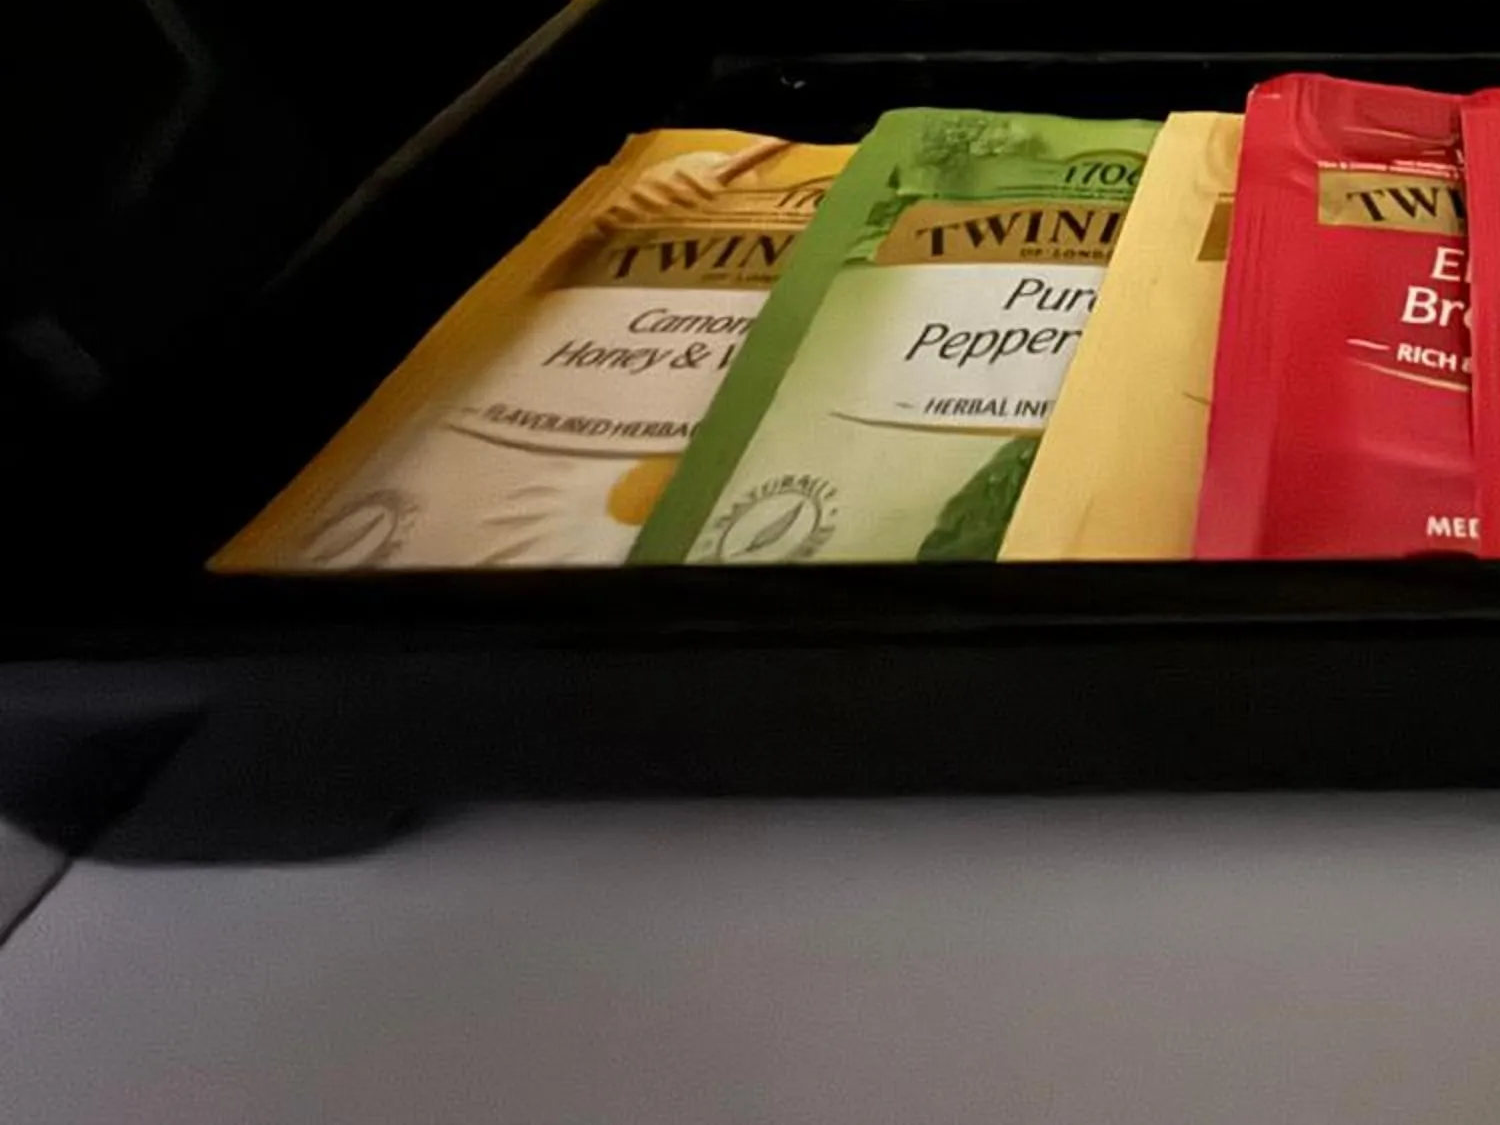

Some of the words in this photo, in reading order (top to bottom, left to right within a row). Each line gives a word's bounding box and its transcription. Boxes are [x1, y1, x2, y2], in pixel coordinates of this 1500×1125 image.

[916, 209, 1122, 257] TWINI
[608, 233, 797, 279] TWIN
[541, 340, 671, 373] Honey
[669, 341, 711, 370] &
[905, 323, 1083, 368] Pepper
[1397, 342, 1457, 372] RICH
[924, 397, 1008, 418] HERBAL
